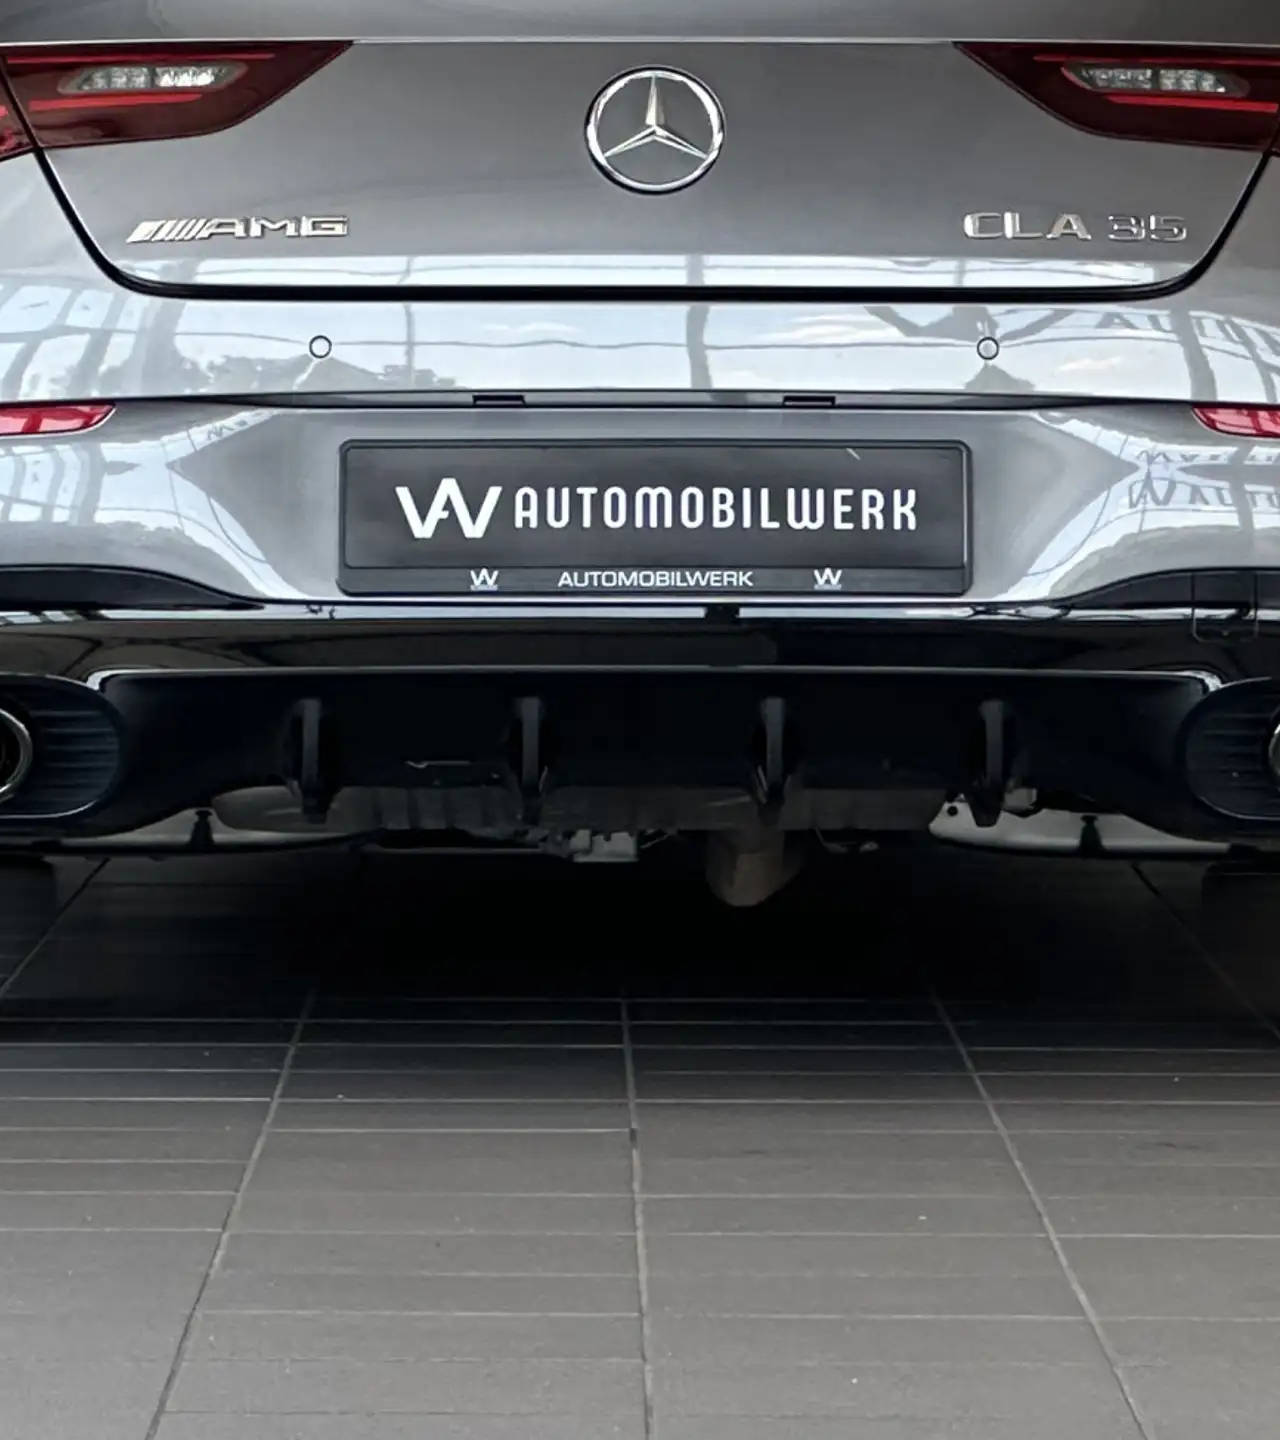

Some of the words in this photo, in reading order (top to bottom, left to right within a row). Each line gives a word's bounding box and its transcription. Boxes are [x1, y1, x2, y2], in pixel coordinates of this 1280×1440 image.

[194, 215, 348, 240] AMG
[963, 211, 1092, 241] CLA
[1107, 214, 1188, 243] 35
[513, 485, 918, 531] AUTOMOBILWERK
[557, 571, 754, 588] AUTOMOBILWERK
